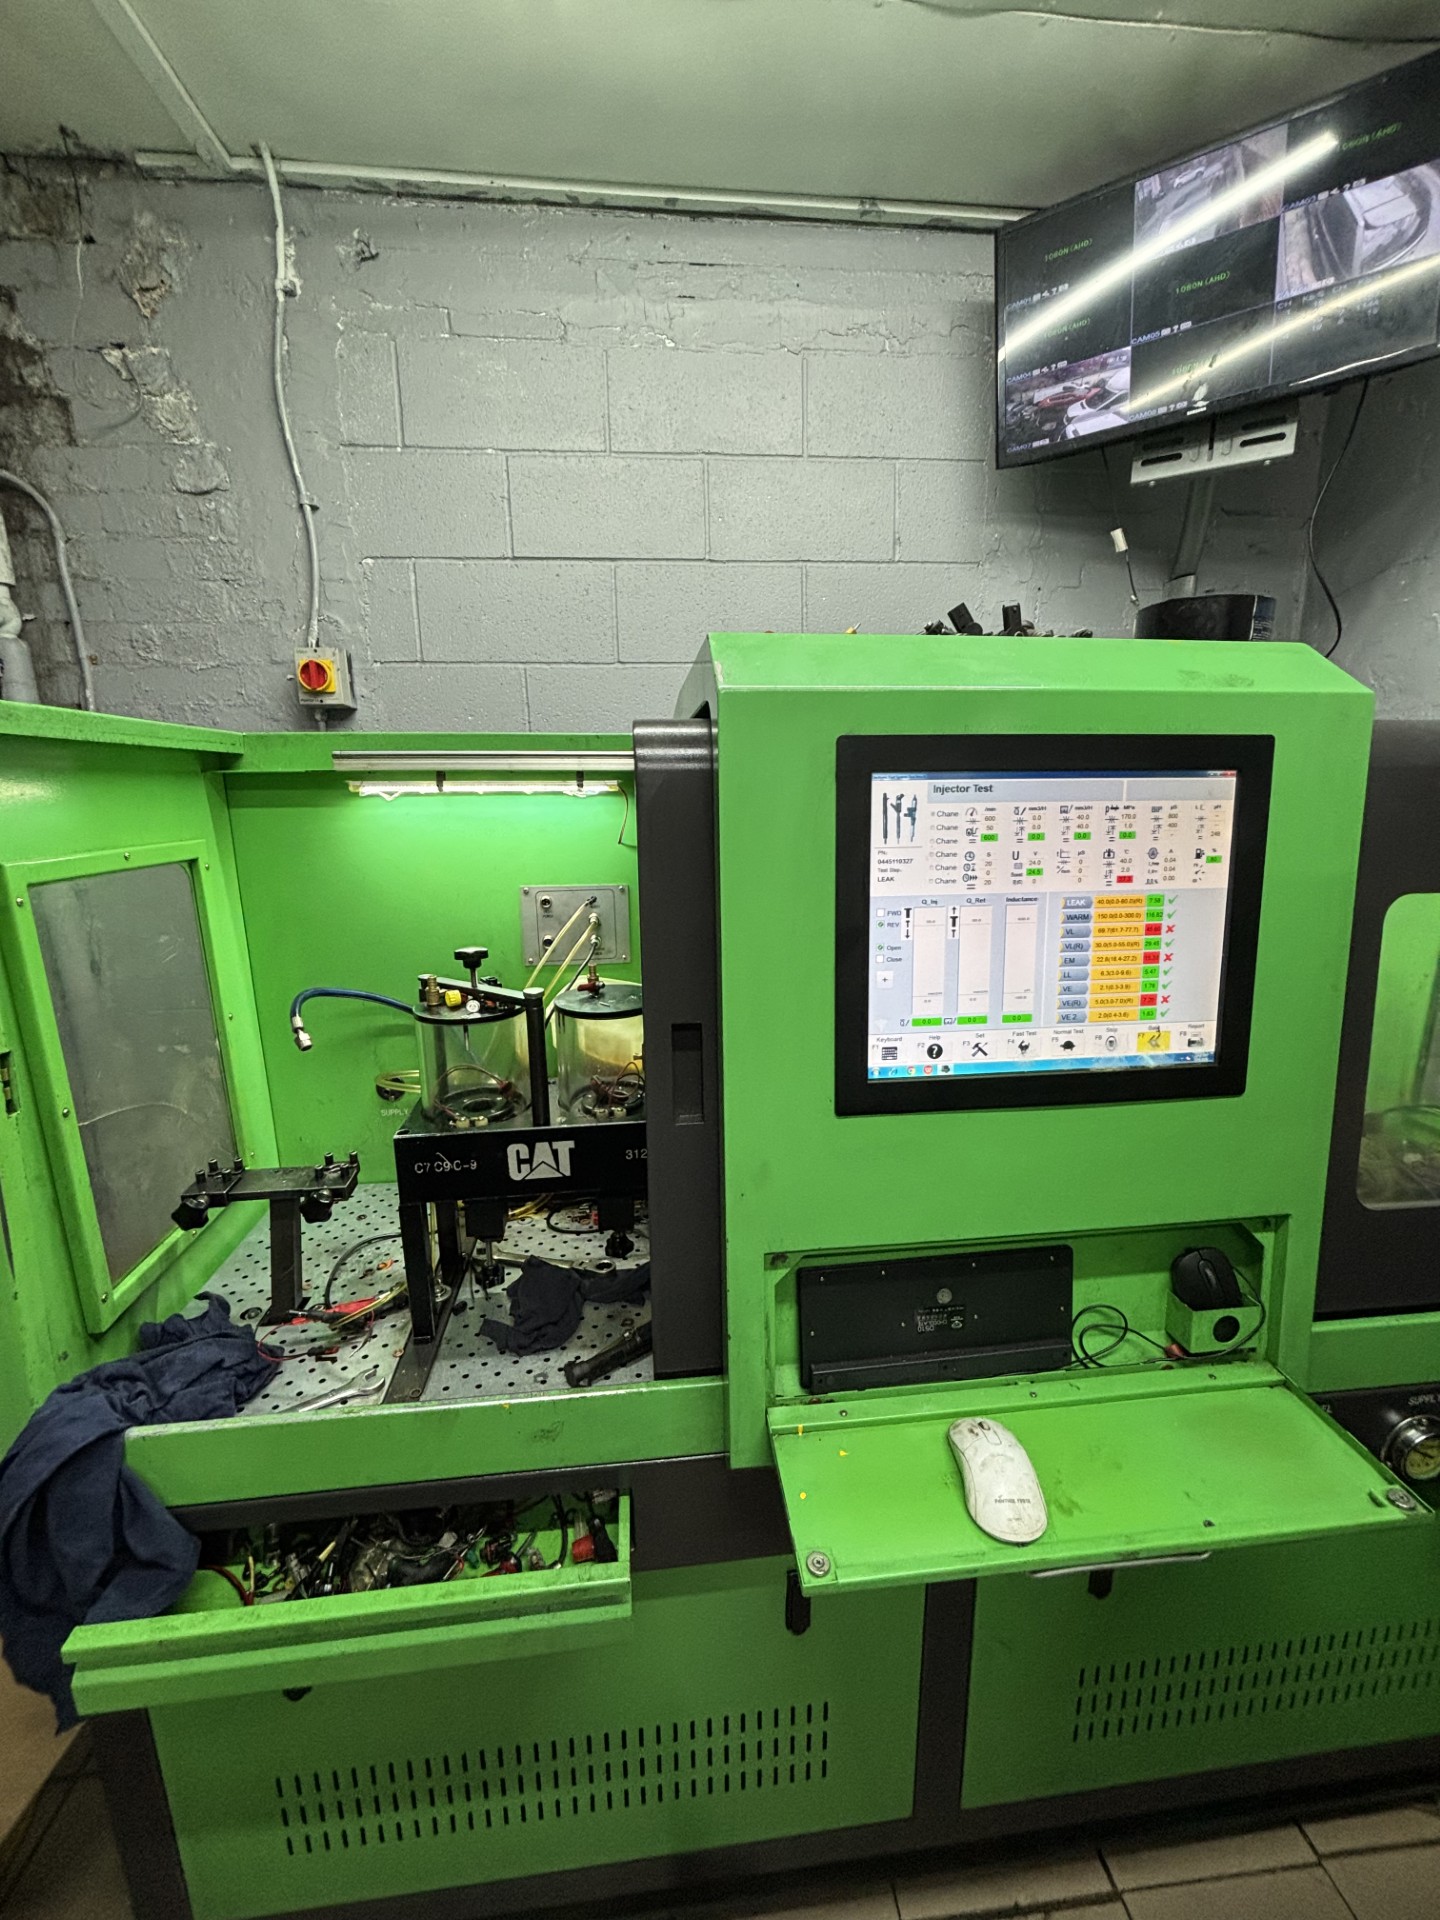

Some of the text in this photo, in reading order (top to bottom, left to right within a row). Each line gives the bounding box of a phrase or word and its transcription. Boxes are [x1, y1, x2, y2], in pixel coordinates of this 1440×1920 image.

[933, 784, 993, 795] Injector Test
[381, 1108, 408, 1116] SUPPLY
[506, 1140, 575, 1181] CAT
[414, 1162, 430, 1174] C7
